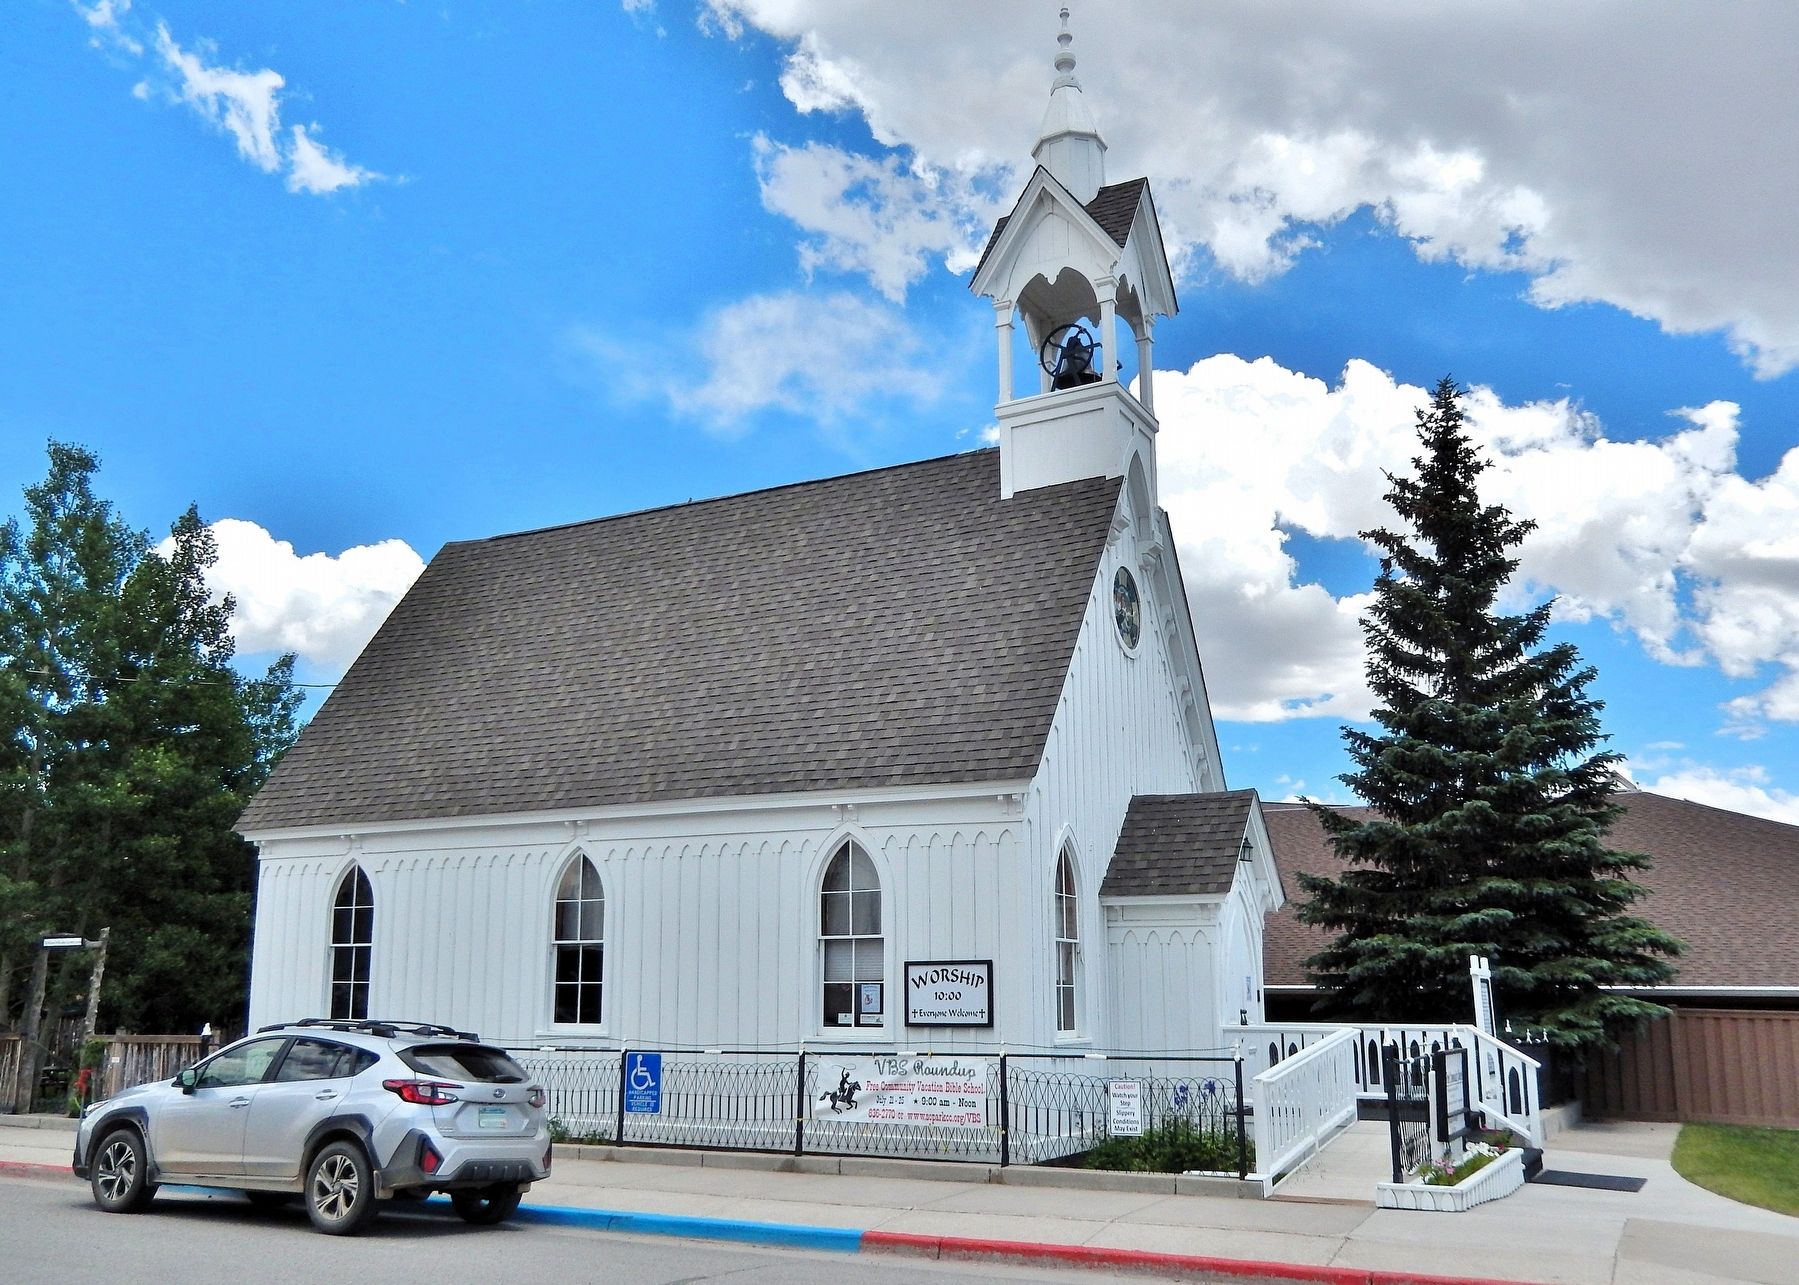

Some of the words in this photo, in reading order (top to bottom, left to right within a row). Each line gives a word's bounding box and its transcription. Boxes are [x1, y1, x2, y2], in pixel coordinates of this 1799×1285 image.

[911, 968, 984, 989] WORSHIP
[934, 991, 962, 1001] 10:00
[919, 1008, 947, 1019] Everyone
[948, 1007, 978, 1018] Welcome
[874, 1059, 908, 1076] VBS
[913, 1060, 976, 1081] Roundup
[866, 1081, 879, 1091] Free
[881, 1081, 915, 1094] Community
[917, 1082, 944, 1092] Vacation
[945, 1085, 961, 1094] Bible
[921, 1096, 938, 1107] 9:00
[939, 1098, 950, 1107] am
[958, 1097, 977, 1108] Noon
